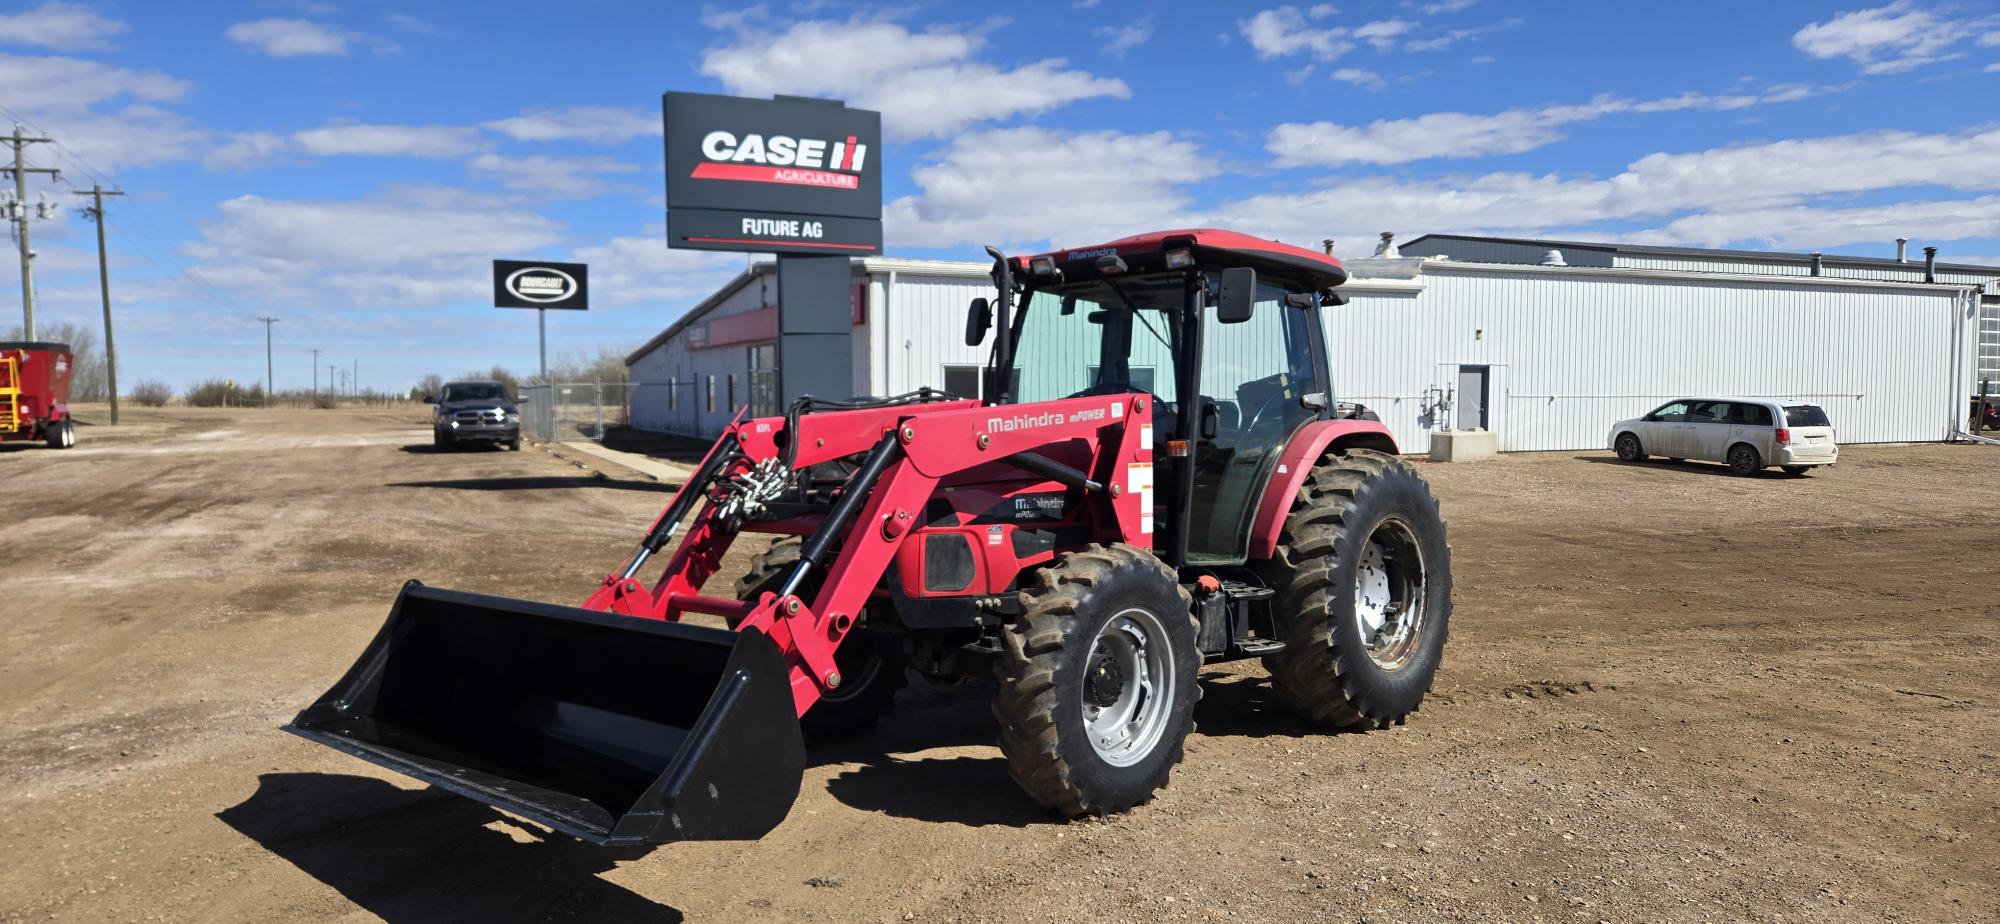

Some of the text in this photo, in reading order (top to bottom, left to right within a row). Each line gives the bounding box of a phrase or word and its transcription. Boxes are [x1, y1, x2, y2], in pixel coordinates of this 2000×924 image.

[702, 131, 826, 168] CASE
[774, 169, 854, 187] AGRICULTURE
[742, 218, 823, 238] FUTURE AG
[1068, 247, 1117, 260] Mahindra
[520, 276, 564, 289] BOURGAULT
[988, 408, 1105, 433] Mahindra mPOWER
